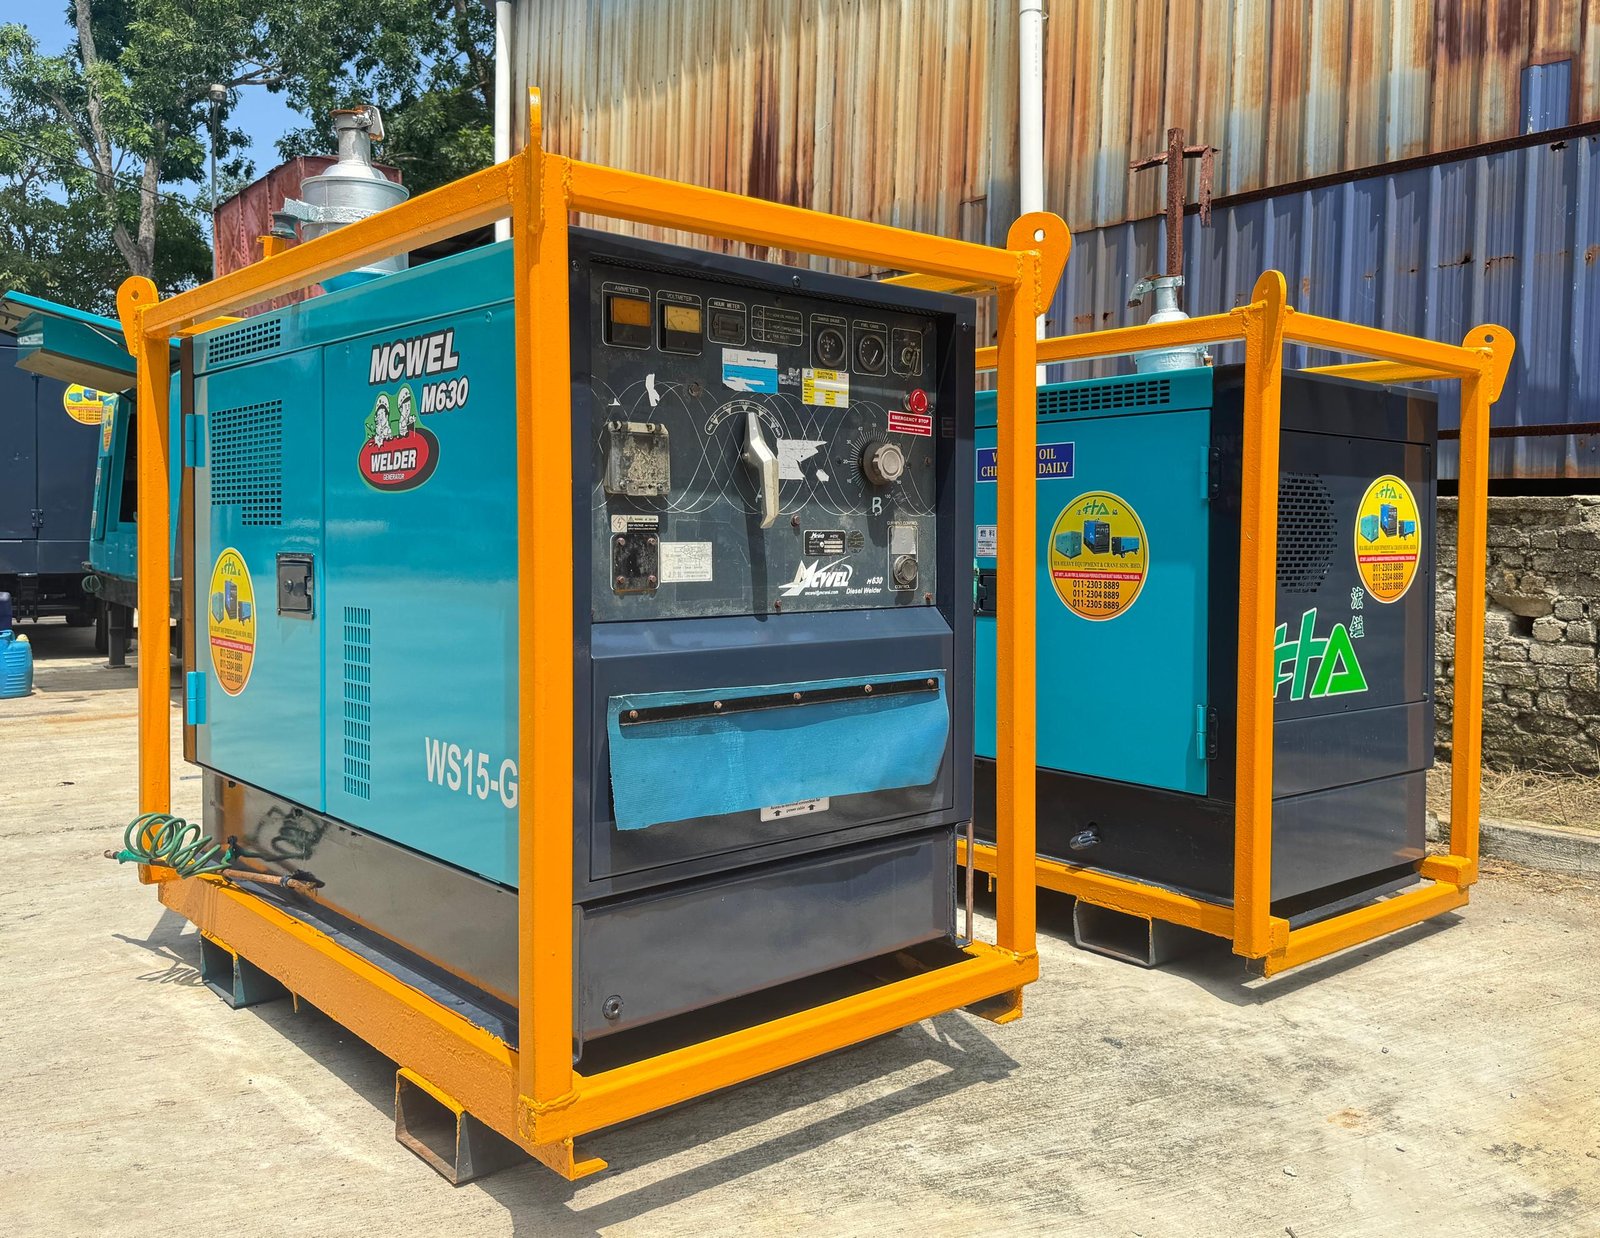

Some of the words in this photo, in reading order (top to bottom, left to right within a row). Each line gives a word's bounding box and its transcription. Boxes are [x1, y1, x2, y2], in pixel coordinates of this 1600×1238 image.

[615, 285, 639, 294] AMMETER
[667, 293, 692, 301] VOLTMETER
[368, 330, 460, 384] MCWEL
[420, 377, 469, 414] M630
[891, 414, 918, 424] EMERGENCY
[1038, 448, 1057, 460] OIL
[370, 449, 418, 473] WELDER
[1038, 461, 1069, 474] DAILY
[383, 473, 405, 481] GENERATOR
[1373, 564, 1393, 572] 011-2303
[1393, 563, 1404, 571] 8889
[1373, 573, 1393, 581] 011-2304
[1072, 580, 1102, 589] 011-2303
[1103, 580, 1120, 589] 8889
[1373, 582, 1393, 591] 011-2305
[846, 587, 863, 595] Diesel
[863, 586, 882, 594] Welder
[1072, 590, 1102, 599] 011-2304
[1103, 590, 1120, 599] 8889
[1072, 599, 1102, 609] 011-2305
[1103, 600, 1120, 609] 8889
[425, 736, 518, 809] WS15-G
